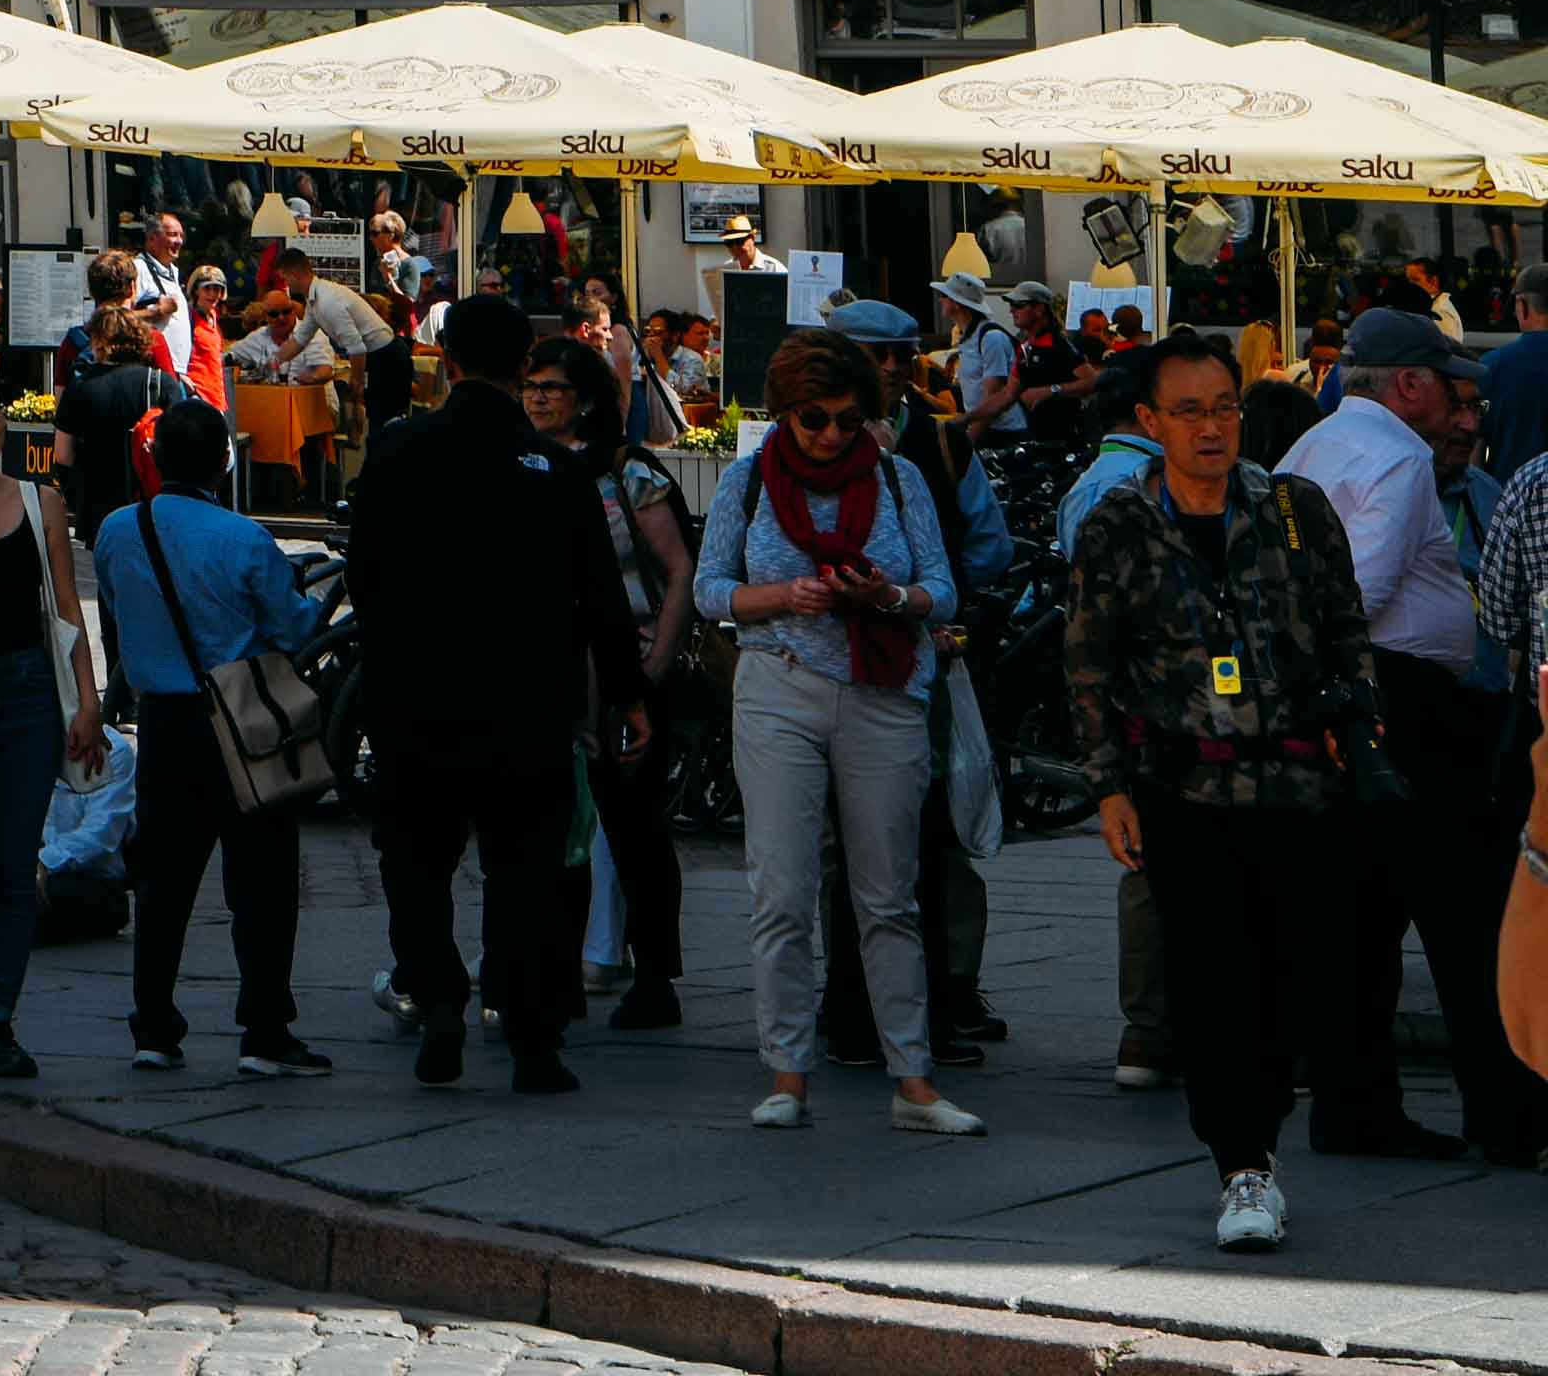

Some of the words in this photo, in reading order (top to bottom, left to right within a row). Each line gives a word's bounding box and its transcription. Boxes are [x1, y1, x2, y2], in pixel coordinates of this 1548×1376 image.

[87, 119, 150, 145] saku
[242, 127, 304, 153] saku
[402, 129, 465, 156] saku
[561, 129, 625, 155] saku
[826, 137, 877, 165] aku
[982, 142, 1051, 171] saku
[1161, 148, 1232, 175] saku
[1341, 154, 1413, 181] saku
[25, 433, 59, 473] bur
